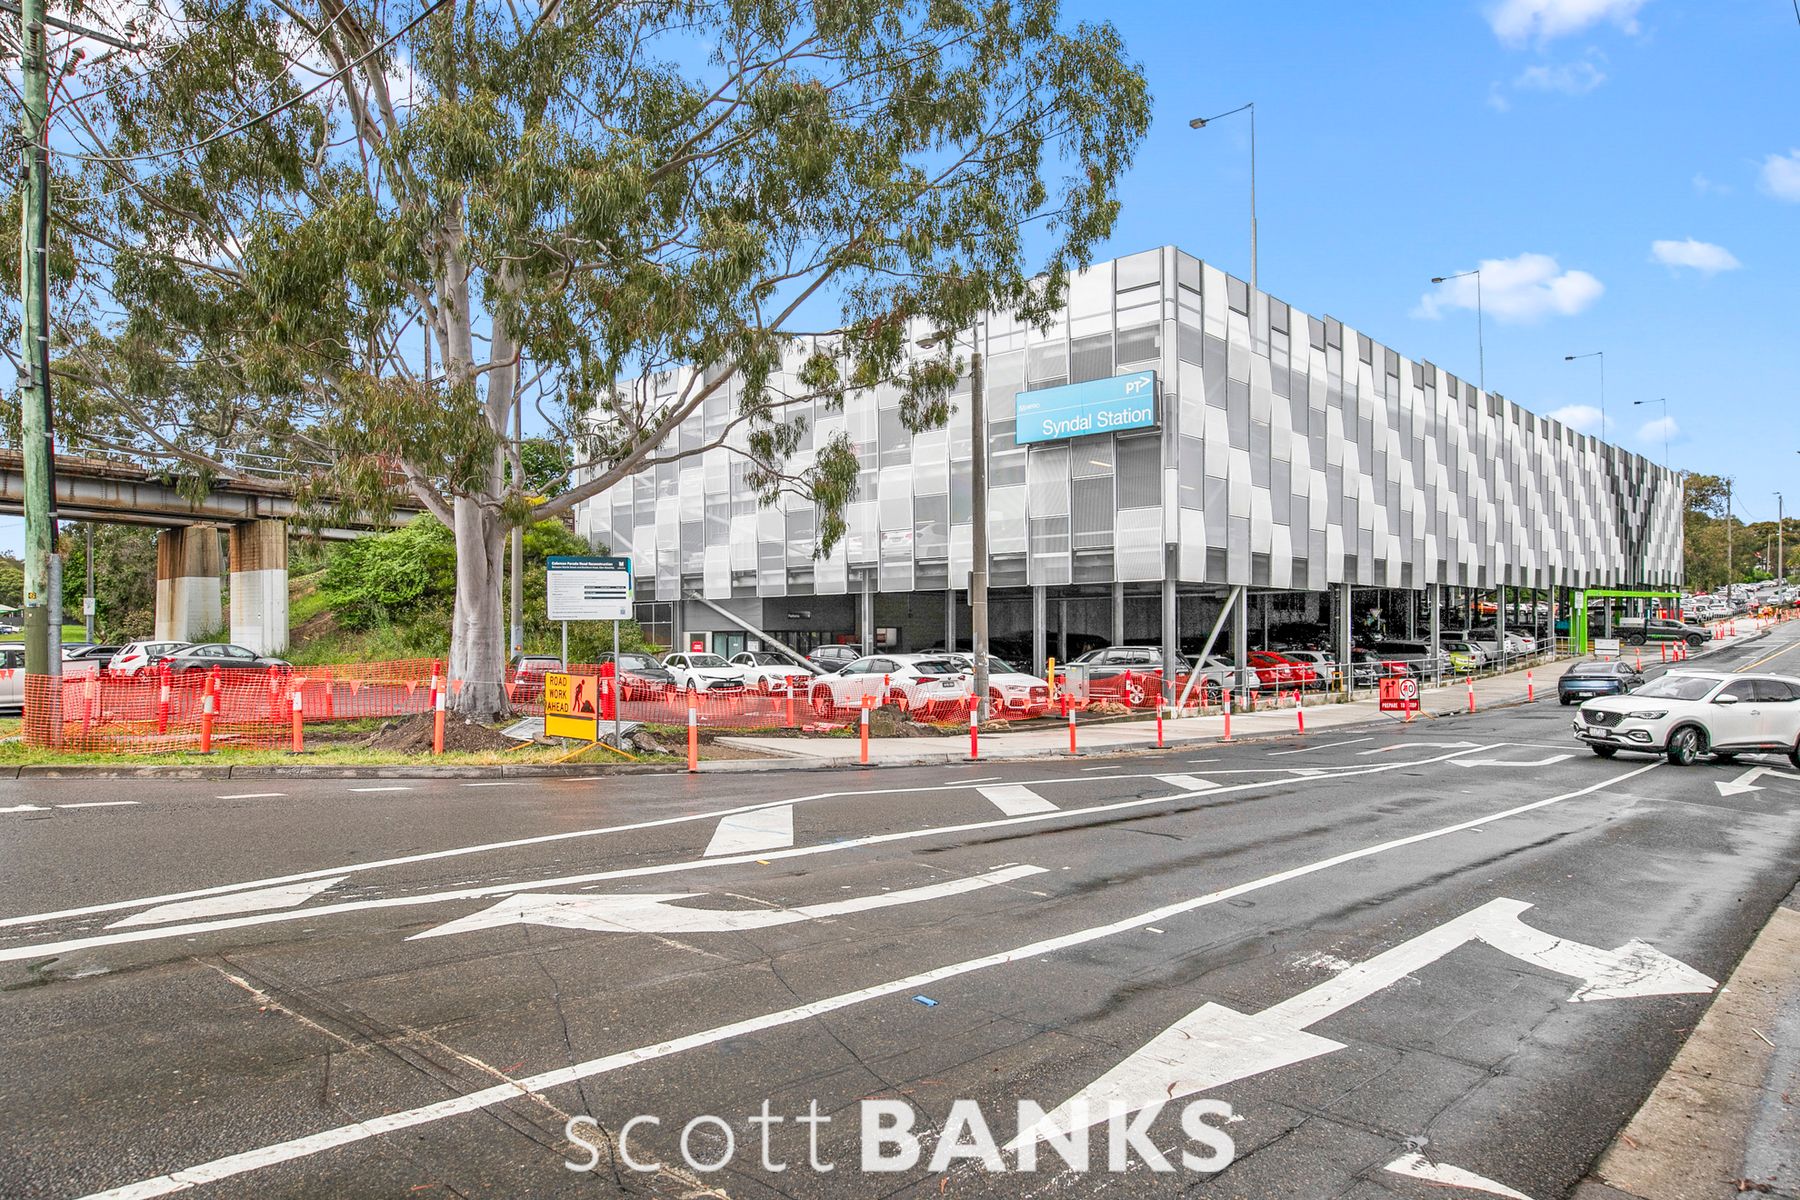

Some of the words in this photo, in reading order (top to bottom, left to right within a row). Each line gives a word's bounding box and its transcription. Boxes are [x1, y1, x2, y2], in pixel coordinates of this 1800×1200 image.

[1043, 413, 1092, 438] Syndal
[1097, 408, 1151, 427] Station
[550, 676, 567, 686] ROAD
[549, 689, 567, 699] WORK
[547, 702, 569, 712] AHEAD
